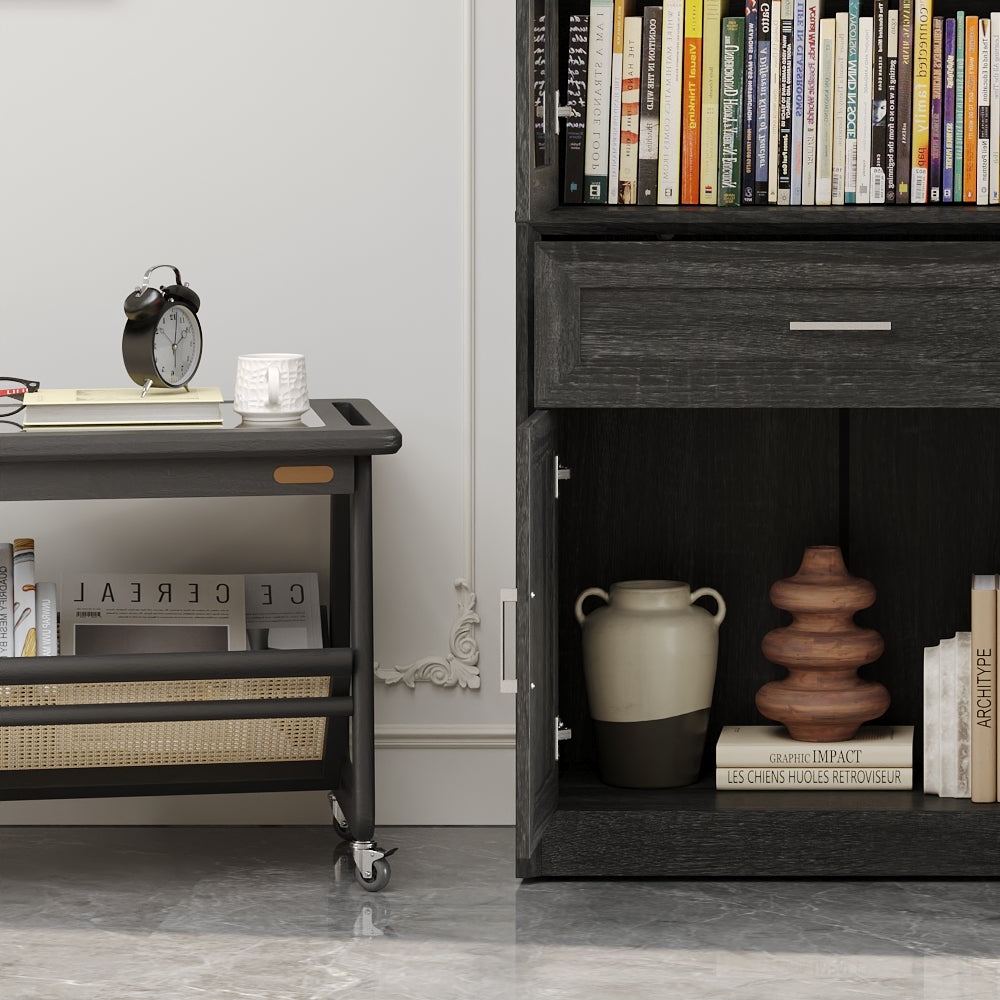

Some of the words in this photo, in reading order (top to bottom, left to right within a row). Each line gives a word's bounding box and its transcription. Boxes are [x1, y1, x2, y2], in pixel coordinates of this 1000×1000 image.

[977, 648, 992, 728] ARCHITYPE
[769, 754, 810, 764] GRAPHIC
[812, 750, 862, 763] IMPACT
[727, 770, 744, 784] LES
[747, 770, 785, 784] CHIENS
[789, 770, 829, 784] HUOLES
[833, 770, 901, 784] RETROVISEUR
